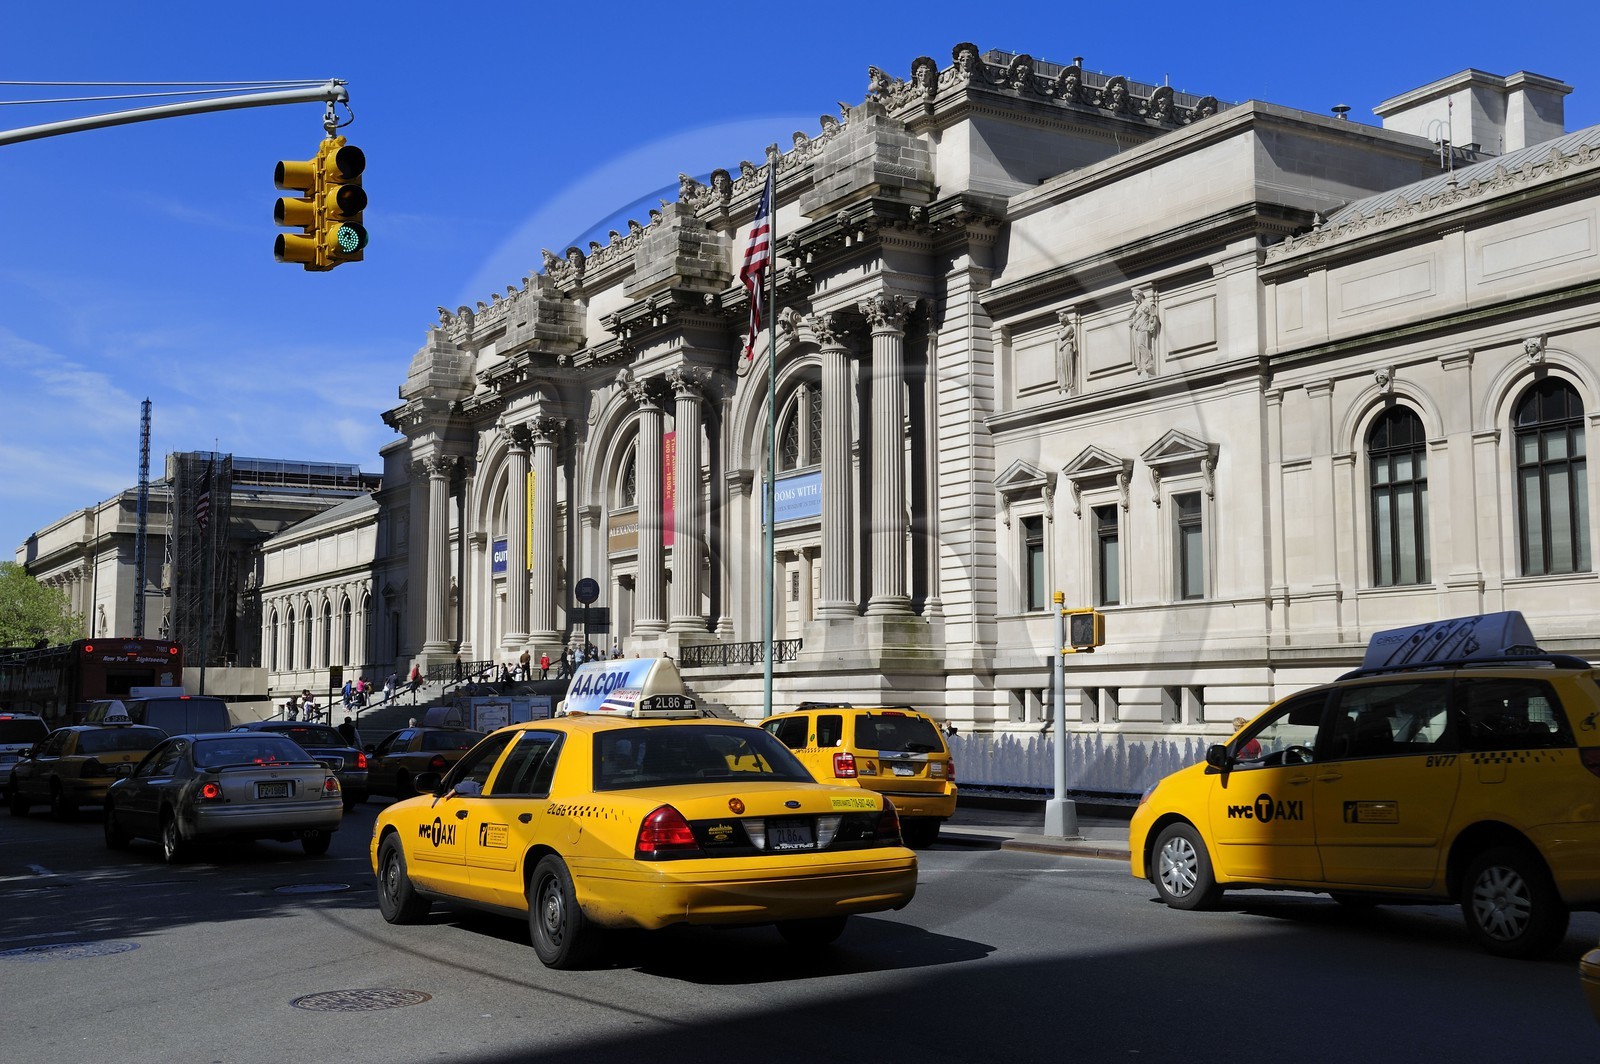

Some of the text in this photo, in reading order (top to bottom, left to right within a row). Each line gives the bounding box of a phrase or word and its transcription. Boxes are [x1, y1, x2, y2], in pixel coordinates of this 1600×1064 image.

[797, 484, 818, 498] WITH
[136, 656, 169, 665] Sightseeing
[570, 671, 631, 696] AA.COM
[655, 697, 681, 709] 2L86
[547, 803, 567, 817] 2L86
[1228, 794, 1304, 823] NYC TAXI
[418, 818, 457, 847] NYC TAXI
